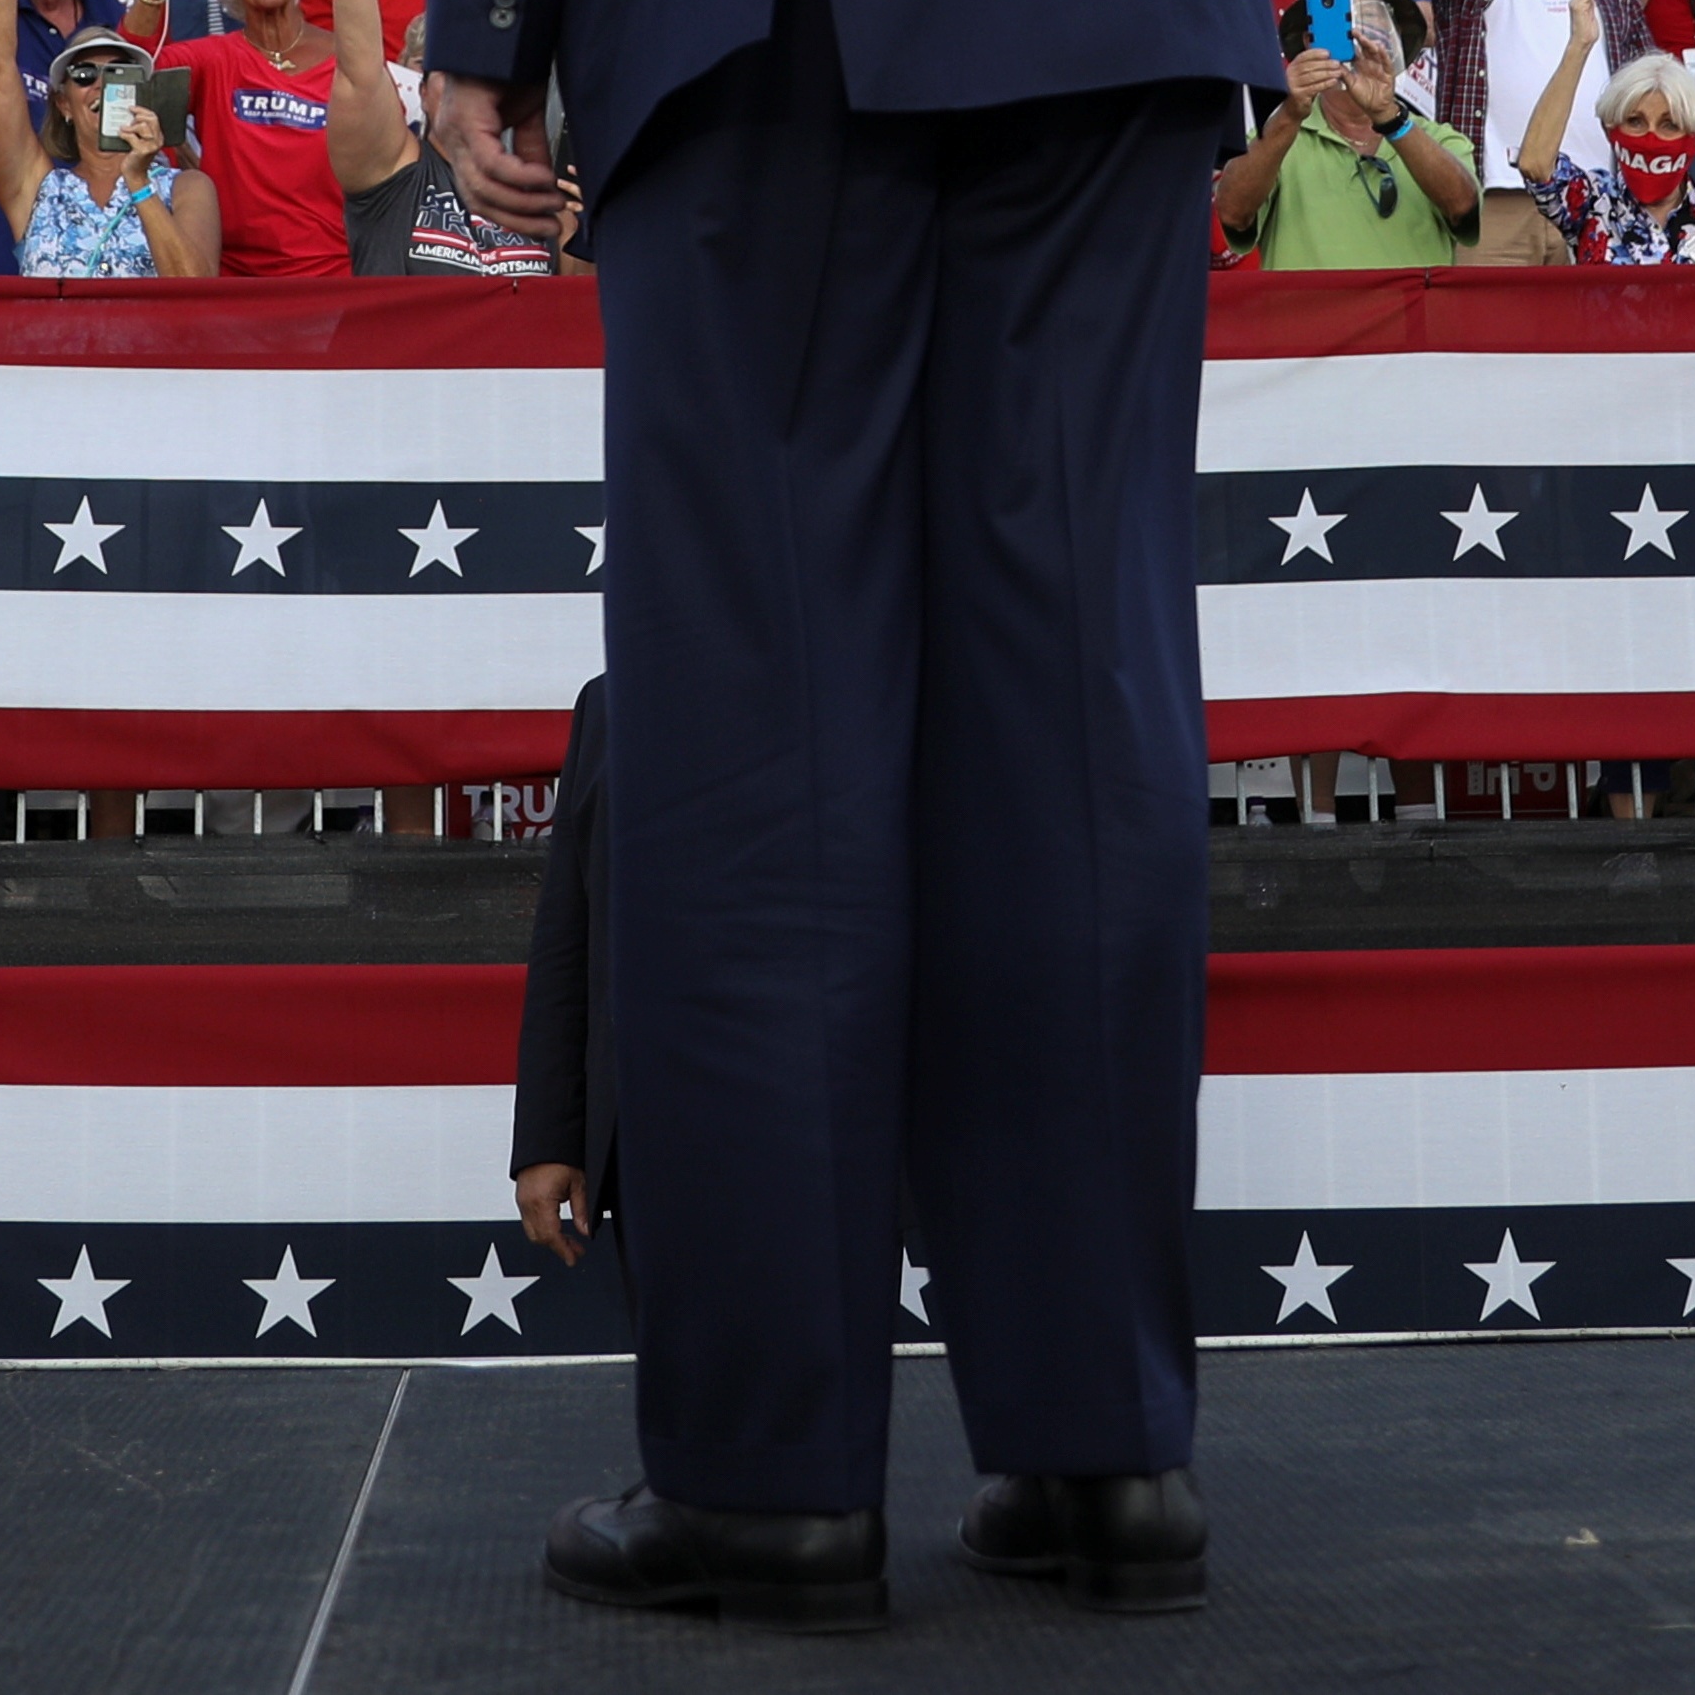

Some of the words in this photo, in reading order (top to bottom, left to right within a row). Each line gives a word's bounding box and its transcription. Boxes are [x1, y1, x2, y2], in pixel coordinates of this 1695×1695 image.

[241, 95, 325, 118] TRUMP
[1615, 141, 1687, 174] MAGA
[415, 243, 481, 266] AMERICAN
[482, 262, 548, 276] PORTSMAN
[462, 785, 555, 823] TRU
